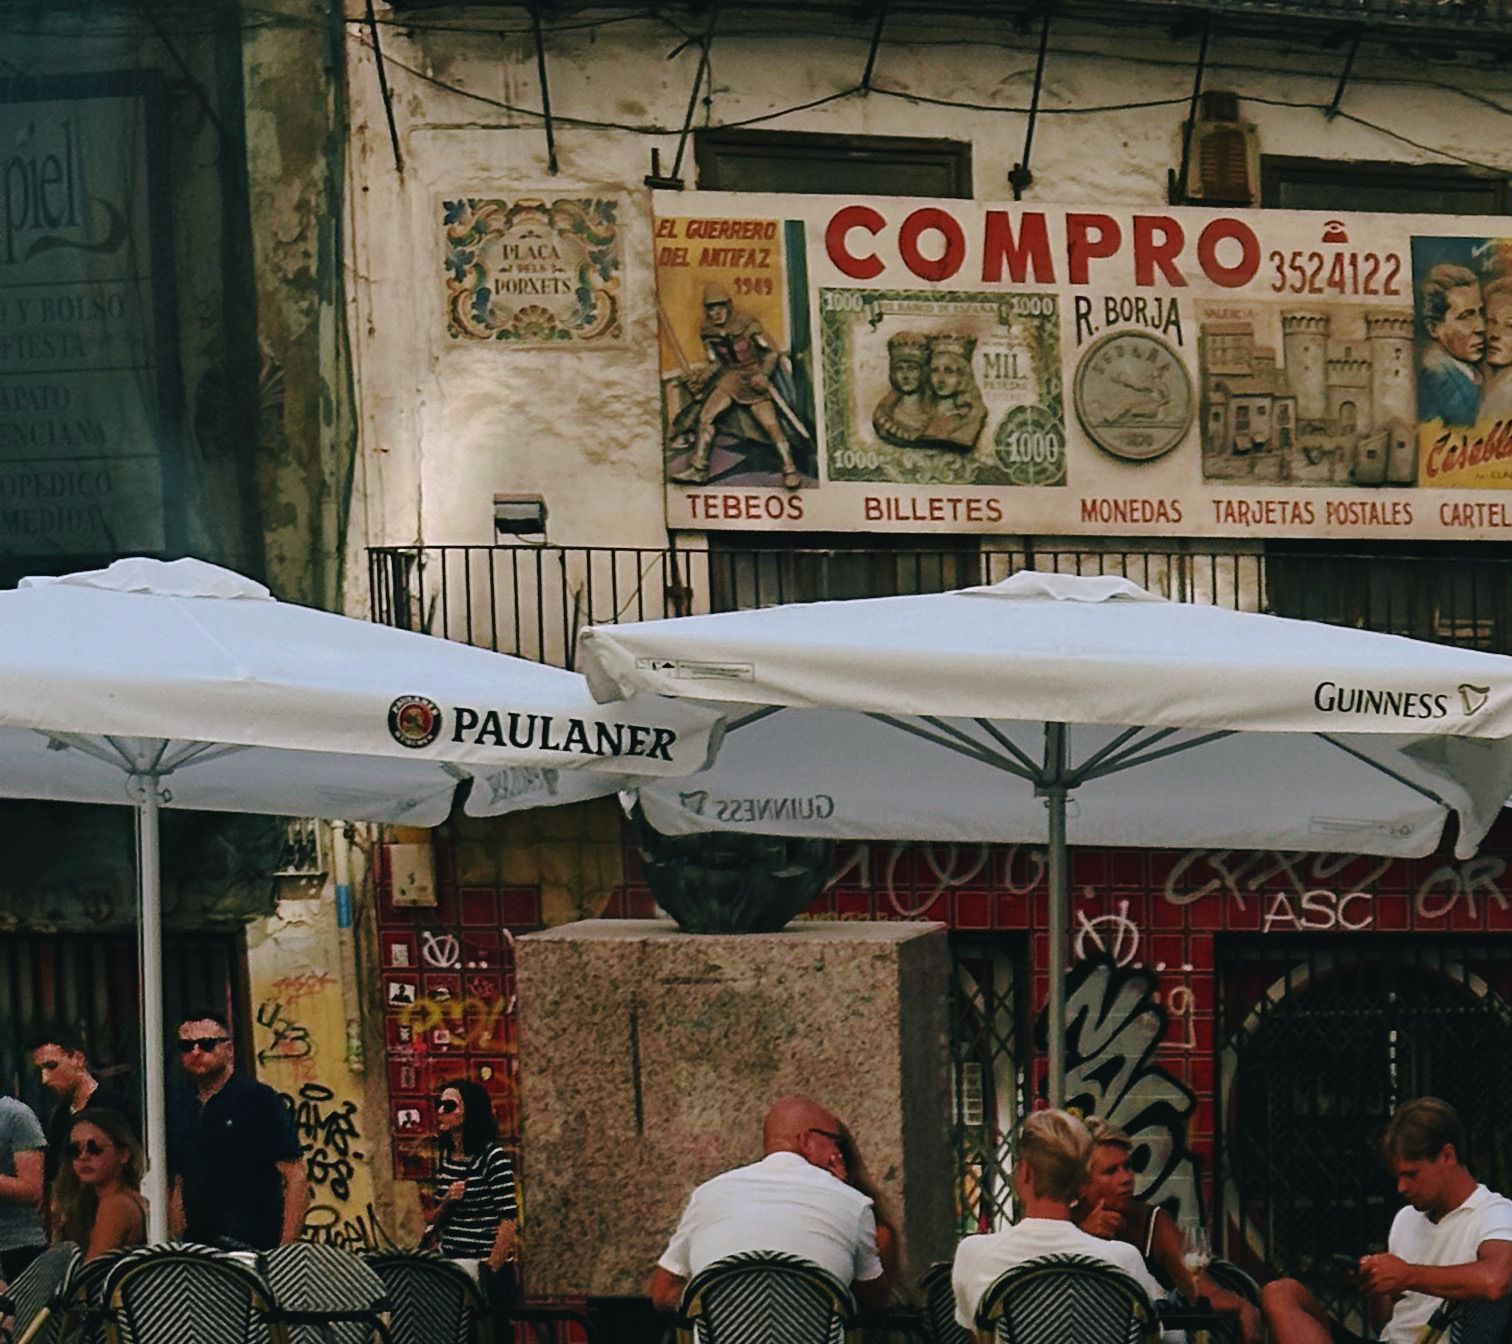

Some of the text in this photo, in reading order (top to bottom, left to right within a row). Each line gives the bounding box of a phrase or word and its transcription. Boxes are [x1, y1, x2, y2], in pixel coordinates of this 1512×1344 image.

[656, 219, 777, 240] EL GUERRERO
[658, 247, 771, 269] DEL ANTIFAZ
[825, 205, 1261, 288] COMPRO
[495, 277, 571, 296] PORXETS
[1269, 250, 1401, 296] 3524122
[824, 291, 864, 311] 1000
[1010, 296, 1054, 316] 1000
[1074, 295, 1184, 347] R. BORJA
[983, 353, 1028, 380] MIL
[833, 449, 880, 469] 1000
[1008, 430, 1058, 463] 1000
[686, 493, 805, 521] TEBEOS
[864, 496, 1004, 523] BILLETES
[1080, 499, 1183, 525] MONEDAS
[1212, 499, 1414, 528] TARJETAS POSTALES
[1315, 681, 1449, 720] GUINNESS
[452, 706, 678, 762] PAULANER
[1261, 889, 1374, 934] ASC
